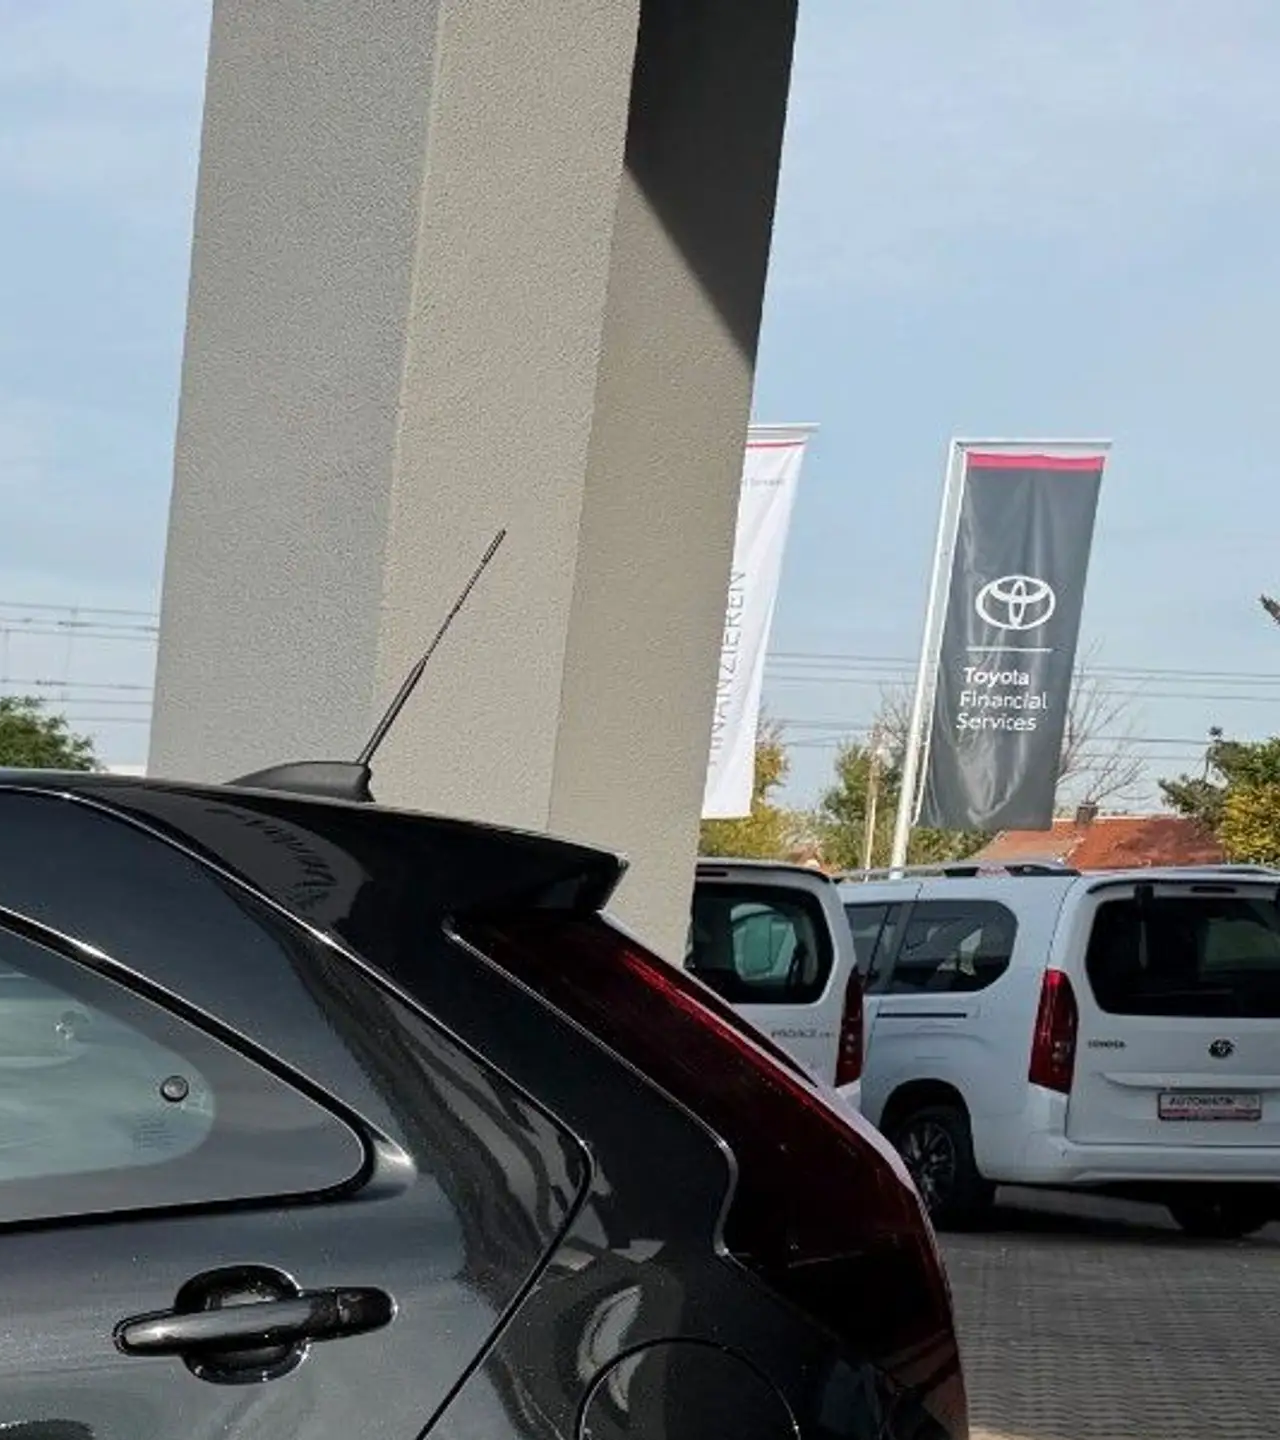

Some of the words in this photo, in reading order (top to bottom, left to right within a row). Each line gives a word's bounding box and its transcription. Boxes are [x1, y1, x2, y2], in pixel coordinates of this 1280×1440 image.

[963, 666, 1030, 689] Toyota
[959, 690, 1048, 709] Financial
[955, 712, 1037, 731] Services
